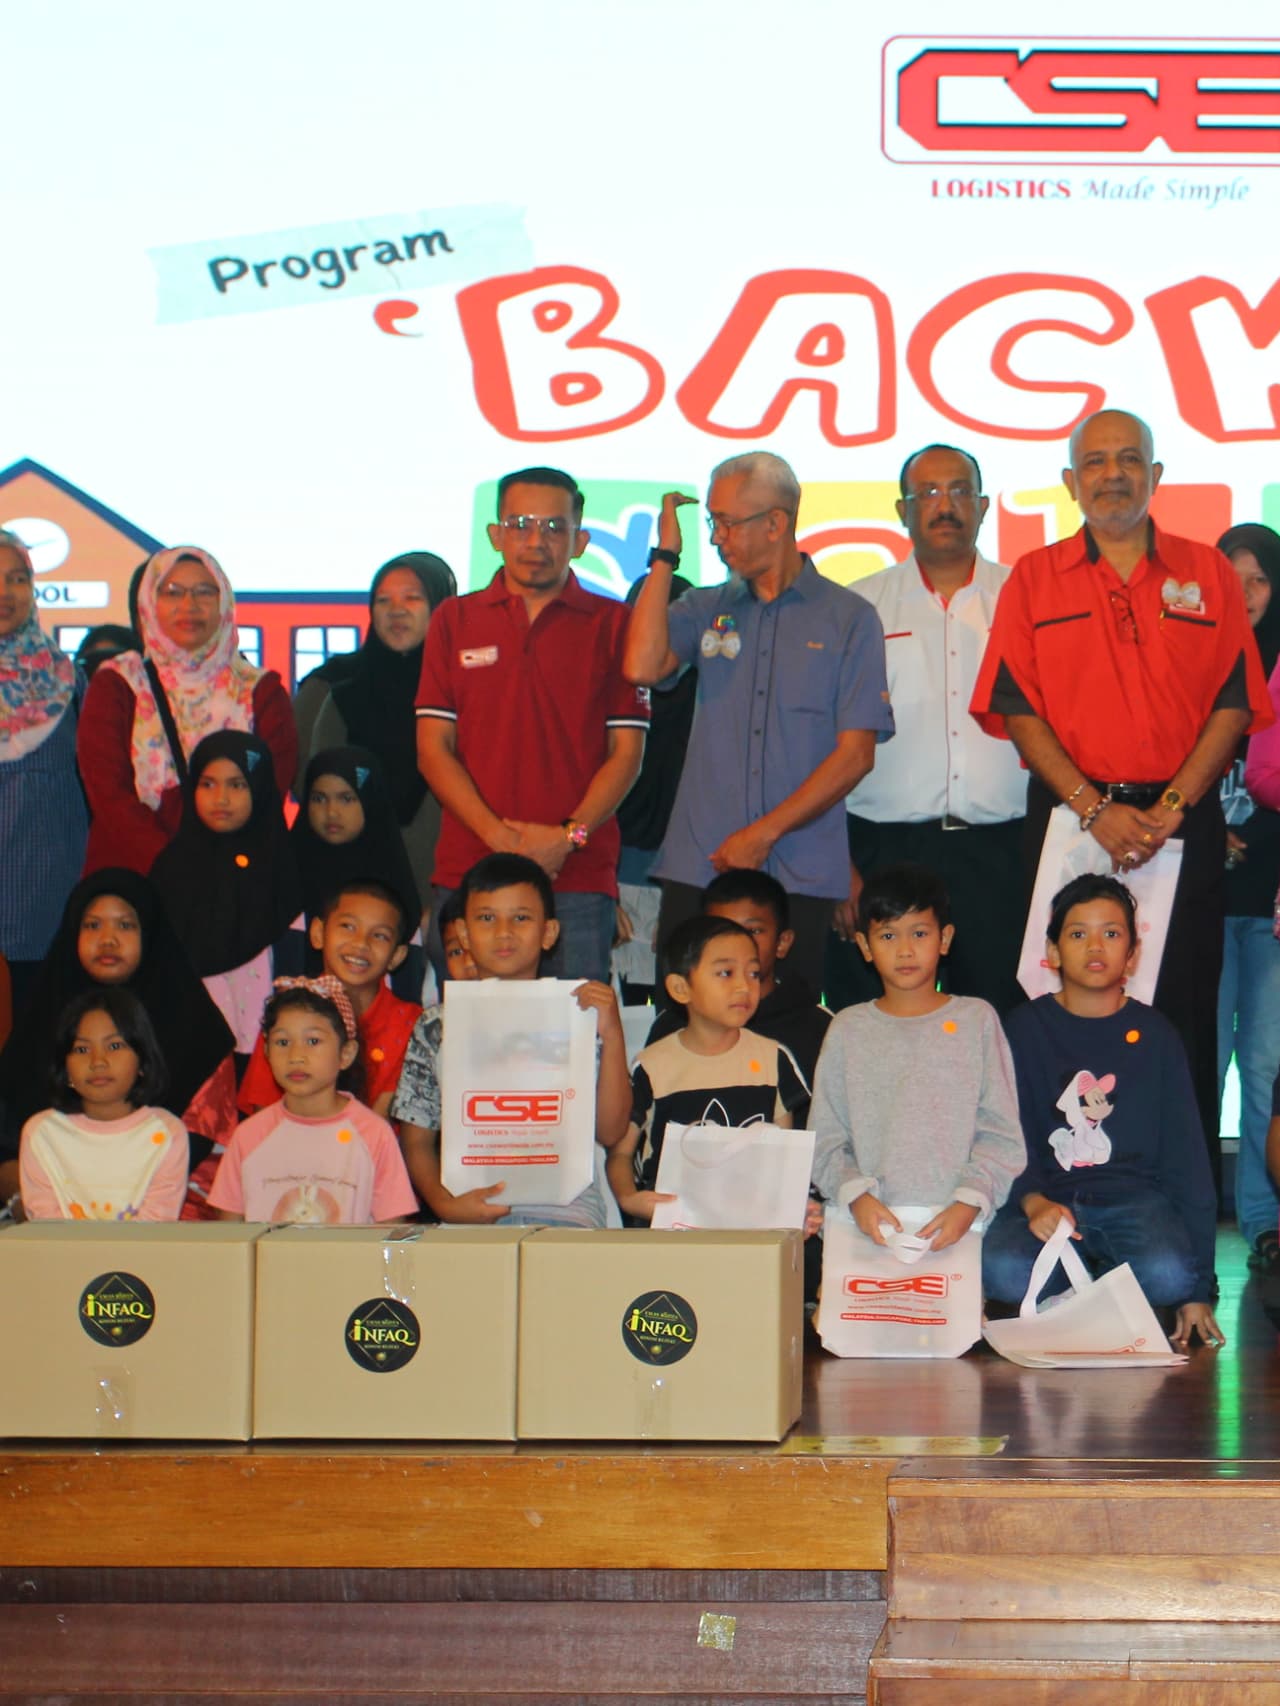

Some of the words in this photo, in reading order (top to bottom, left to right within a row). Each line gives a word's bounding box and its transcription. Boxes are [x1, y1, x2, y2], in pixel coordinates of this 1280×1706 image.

[931, 178, 1071, 199] LOGISTICS
[1085, 177, 1157, 200] Made
[1165, 176, 1251, 209] Simple
[207, 229, 454, 293] Program
[467, 1095, 559, 1122] CSE
[848, 1276, 944, 1295] CSE
